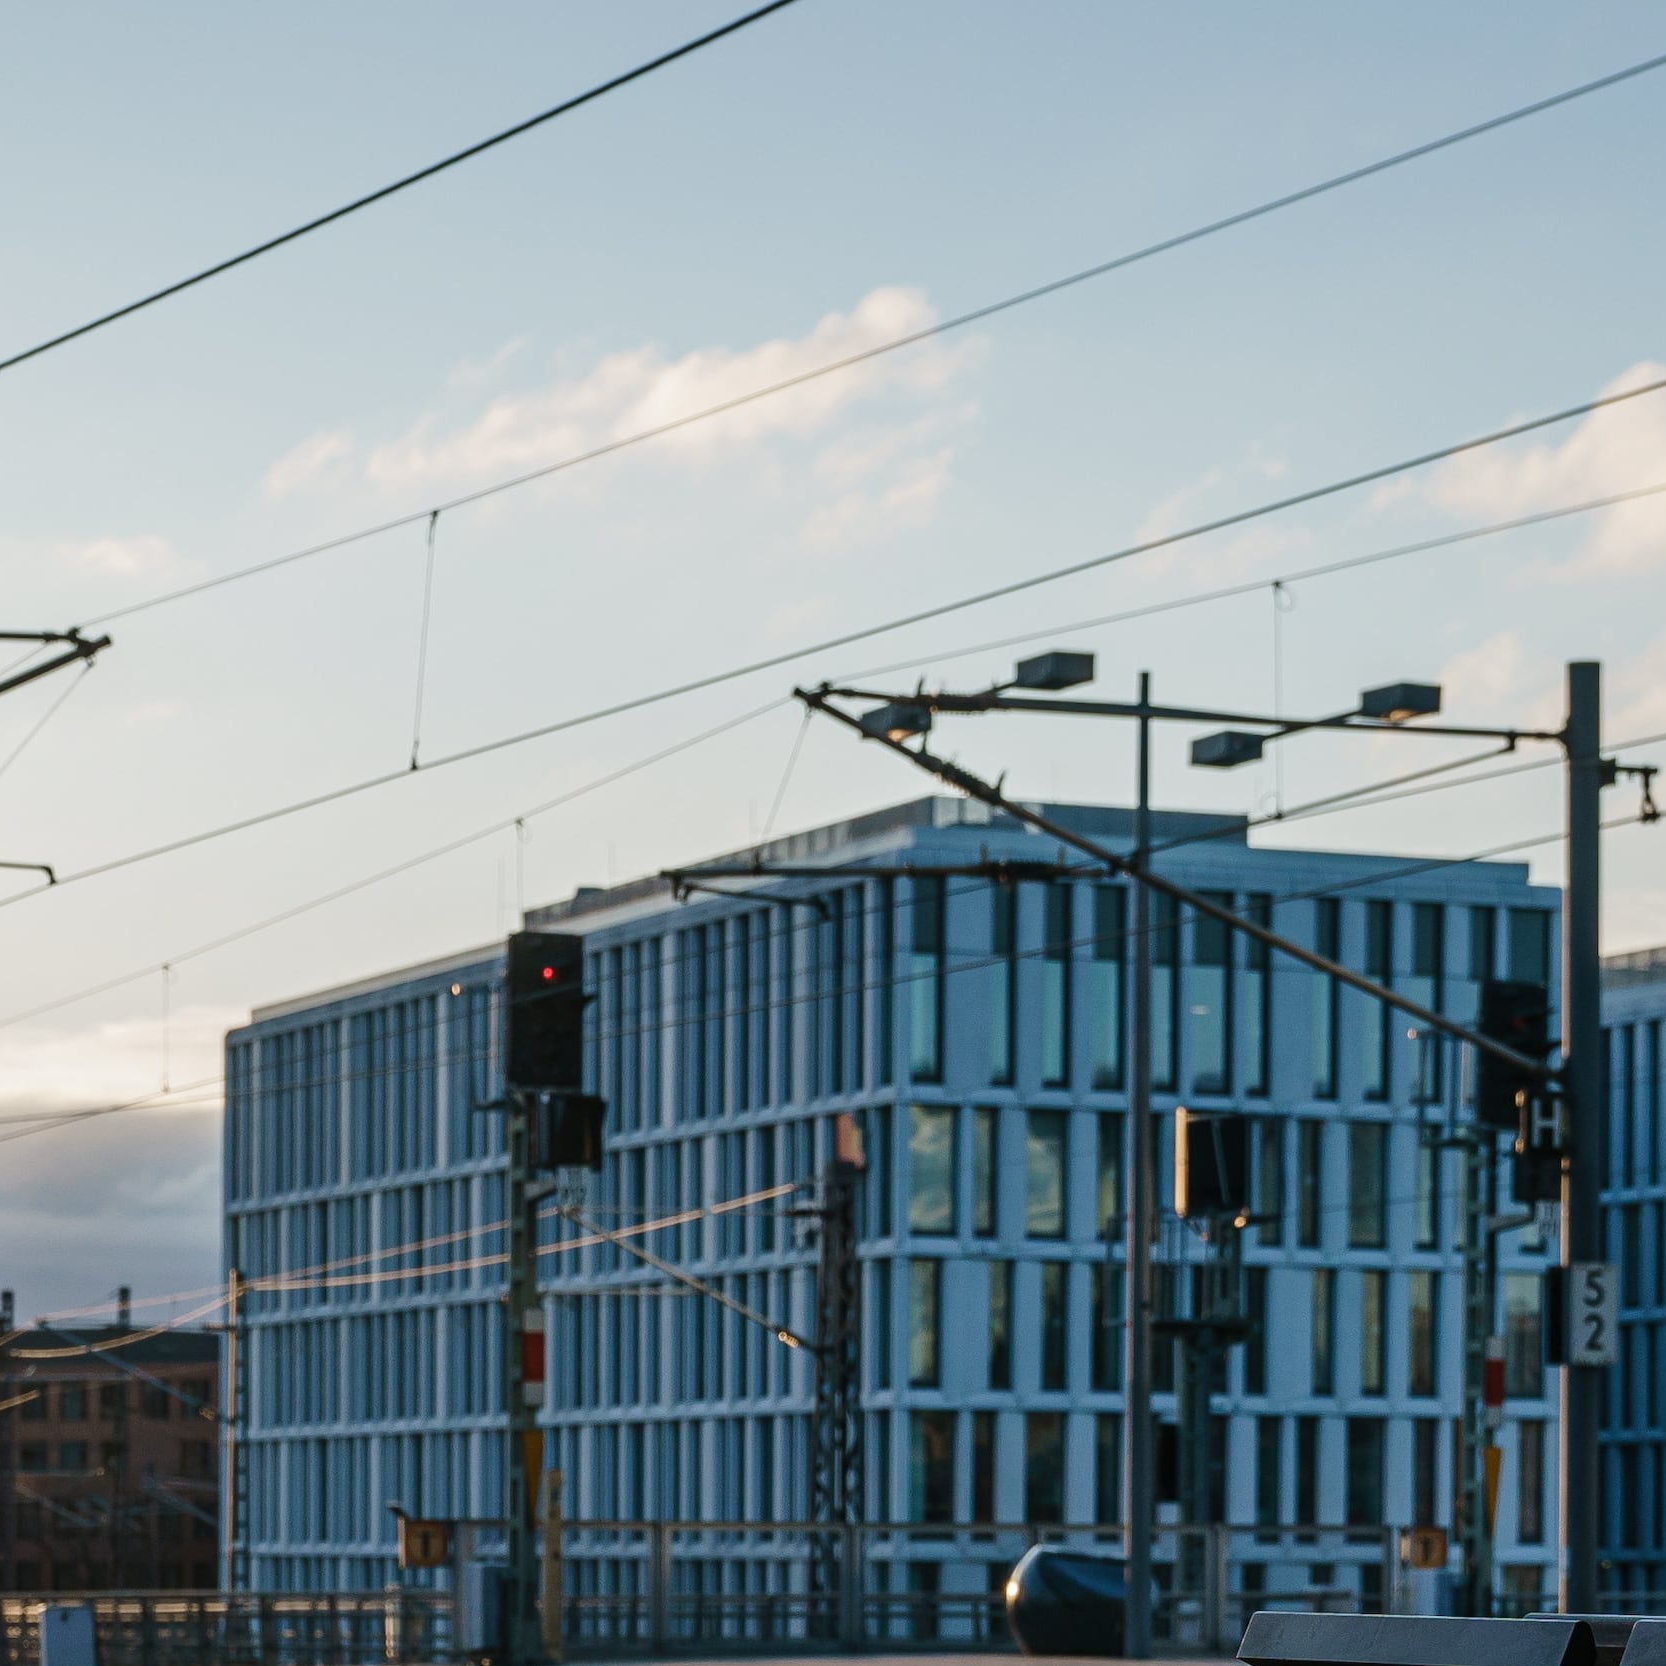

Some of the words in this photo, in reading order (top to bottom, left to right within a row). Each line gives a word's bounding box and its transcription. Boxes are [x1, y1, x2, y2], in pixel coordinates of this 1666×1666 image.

[1532, 1098, 1563, 1148] H
[1583, 1268, 1605, 1307] 5
[1584, 1312, 1604, 1352] 2
